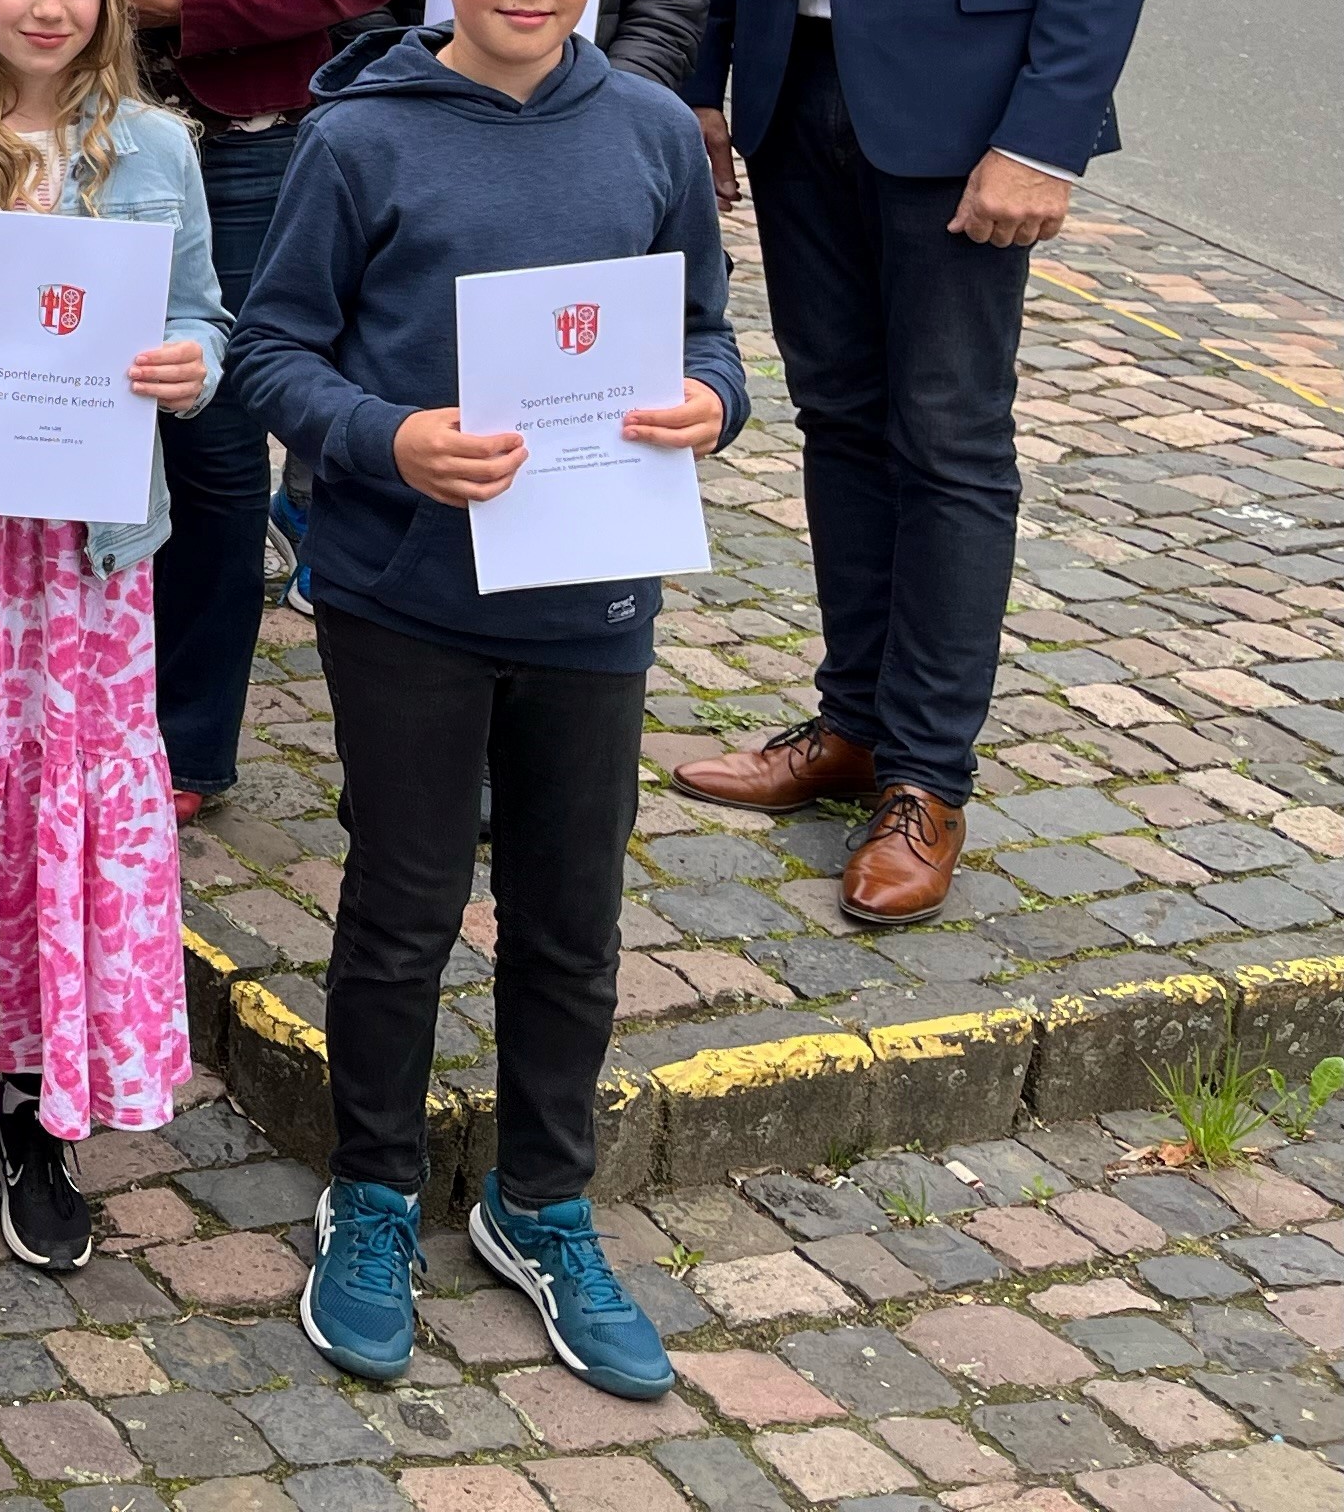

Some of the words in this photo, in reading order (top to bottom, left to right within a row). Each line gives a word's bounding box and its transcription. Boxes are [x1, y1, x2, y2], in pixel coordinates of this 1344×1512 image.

[84, 375, 111, 387] 2023
[11, 391, 69, 406] Gemeinde
[71, 396, 115, 408] Kiedrich
[520, 391, 605, 409] Sportlerehrung
[607, 385, 635, 398] 2023
[515, 421, 534, 432] der
[536, 413, 594, 429] Gemeinde
